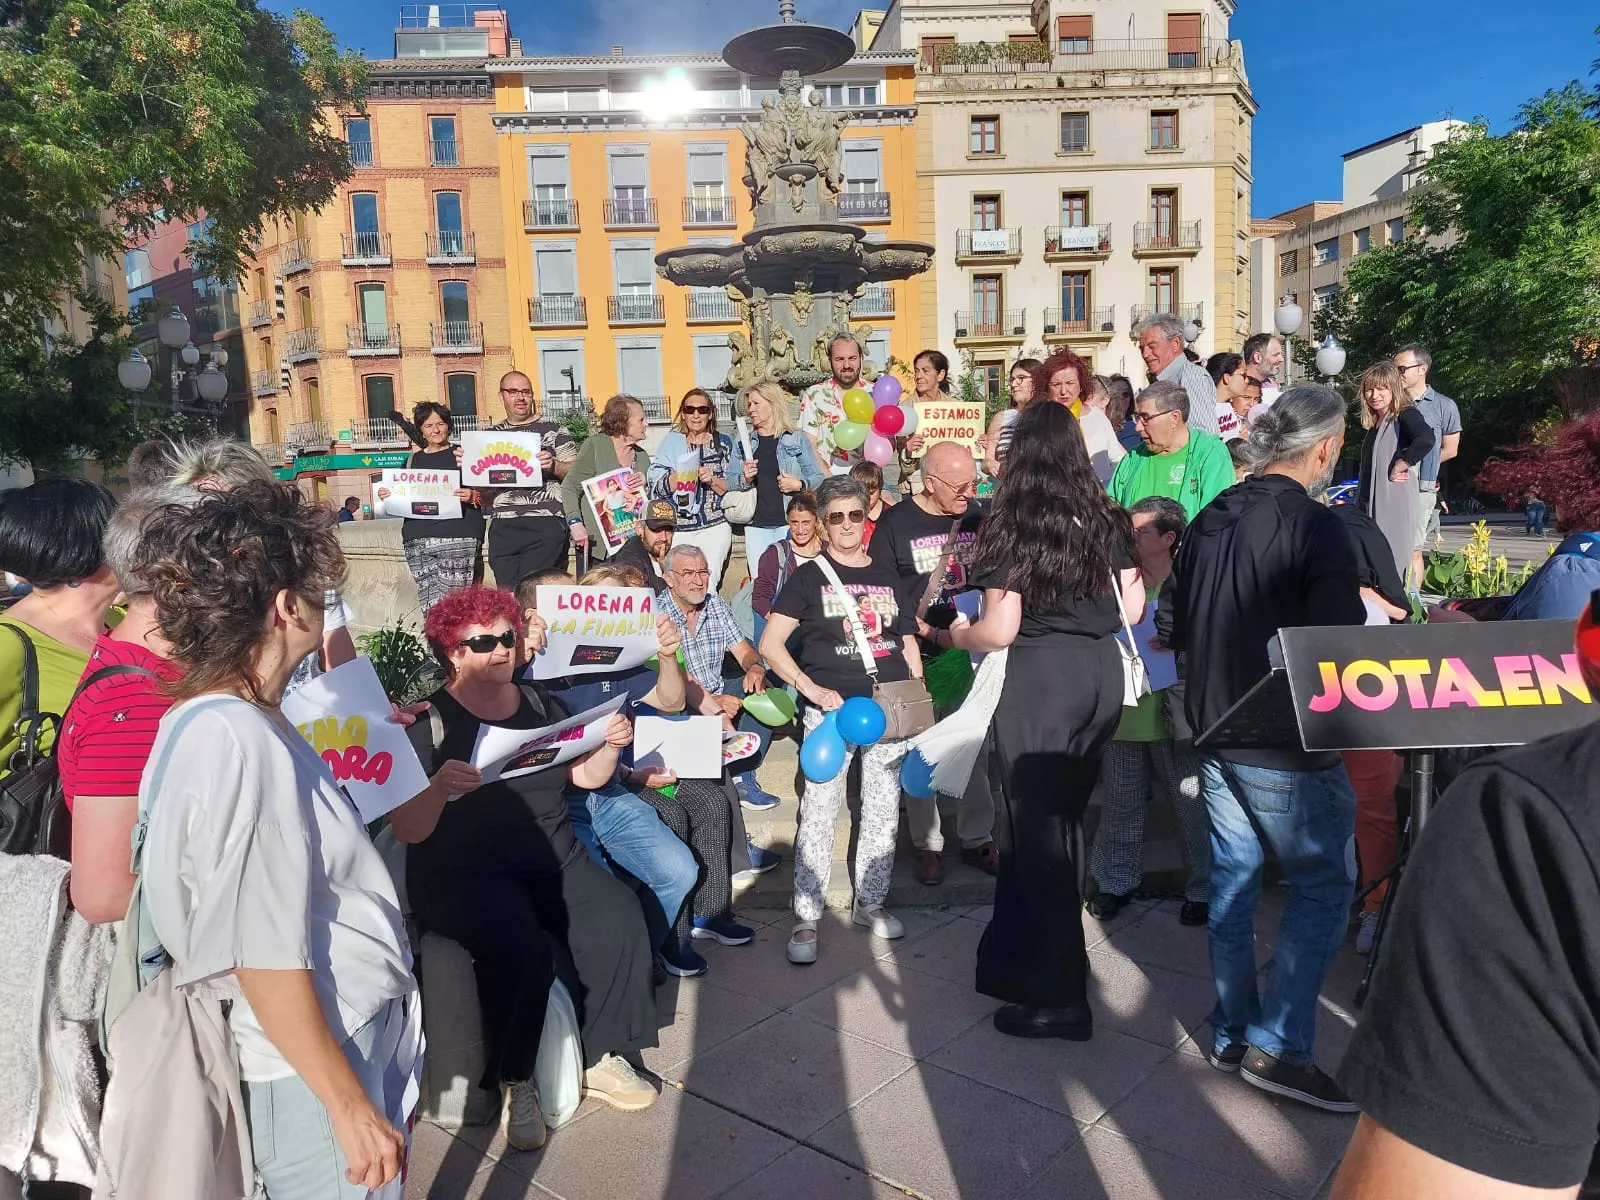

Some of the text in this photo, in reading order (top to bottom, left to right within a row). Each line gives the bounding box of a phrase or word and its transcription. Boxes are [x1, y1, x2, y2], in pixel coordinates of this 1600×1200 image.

[924, 408, 980, 420] ESTAMOS
[922, 427, 974, 438] CONTIGO
[393, 473, 449, 483] LORENA A
[557, 593, 651, 615] LORENA A
[550, 618, 577, 635] LA
[1308, 653, 1593, 712] JOTALEN
